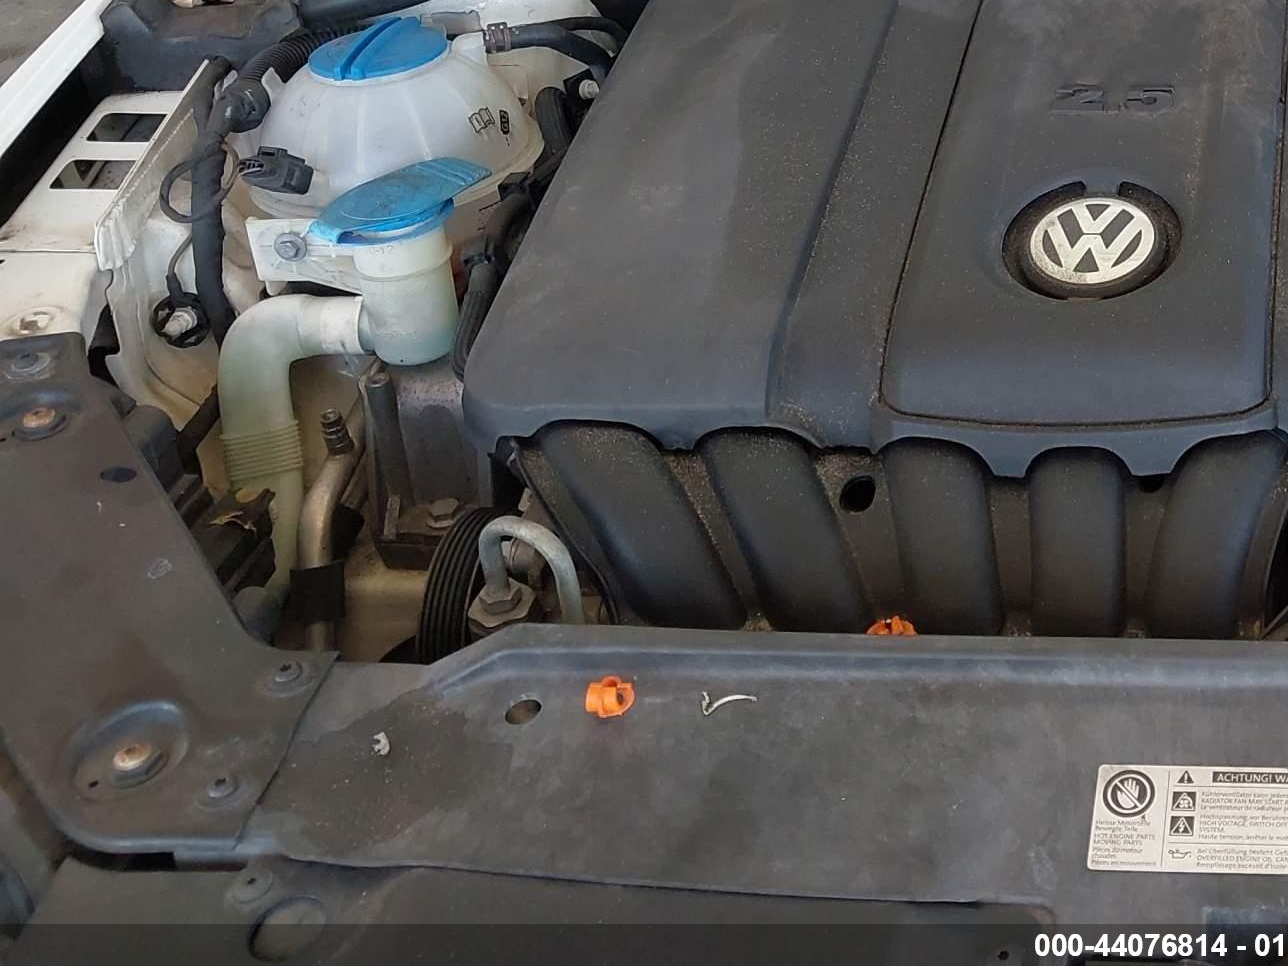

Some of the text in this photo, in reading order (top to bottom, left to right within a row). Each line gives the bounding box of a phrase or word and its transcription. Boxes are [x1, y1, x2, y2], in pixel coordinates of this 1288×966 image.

[1049, 84, 1175, 115] 2.5
[1030, 197, 1155, 284] VW
[1216, 773, 1272, 783] ACHTUNG!
